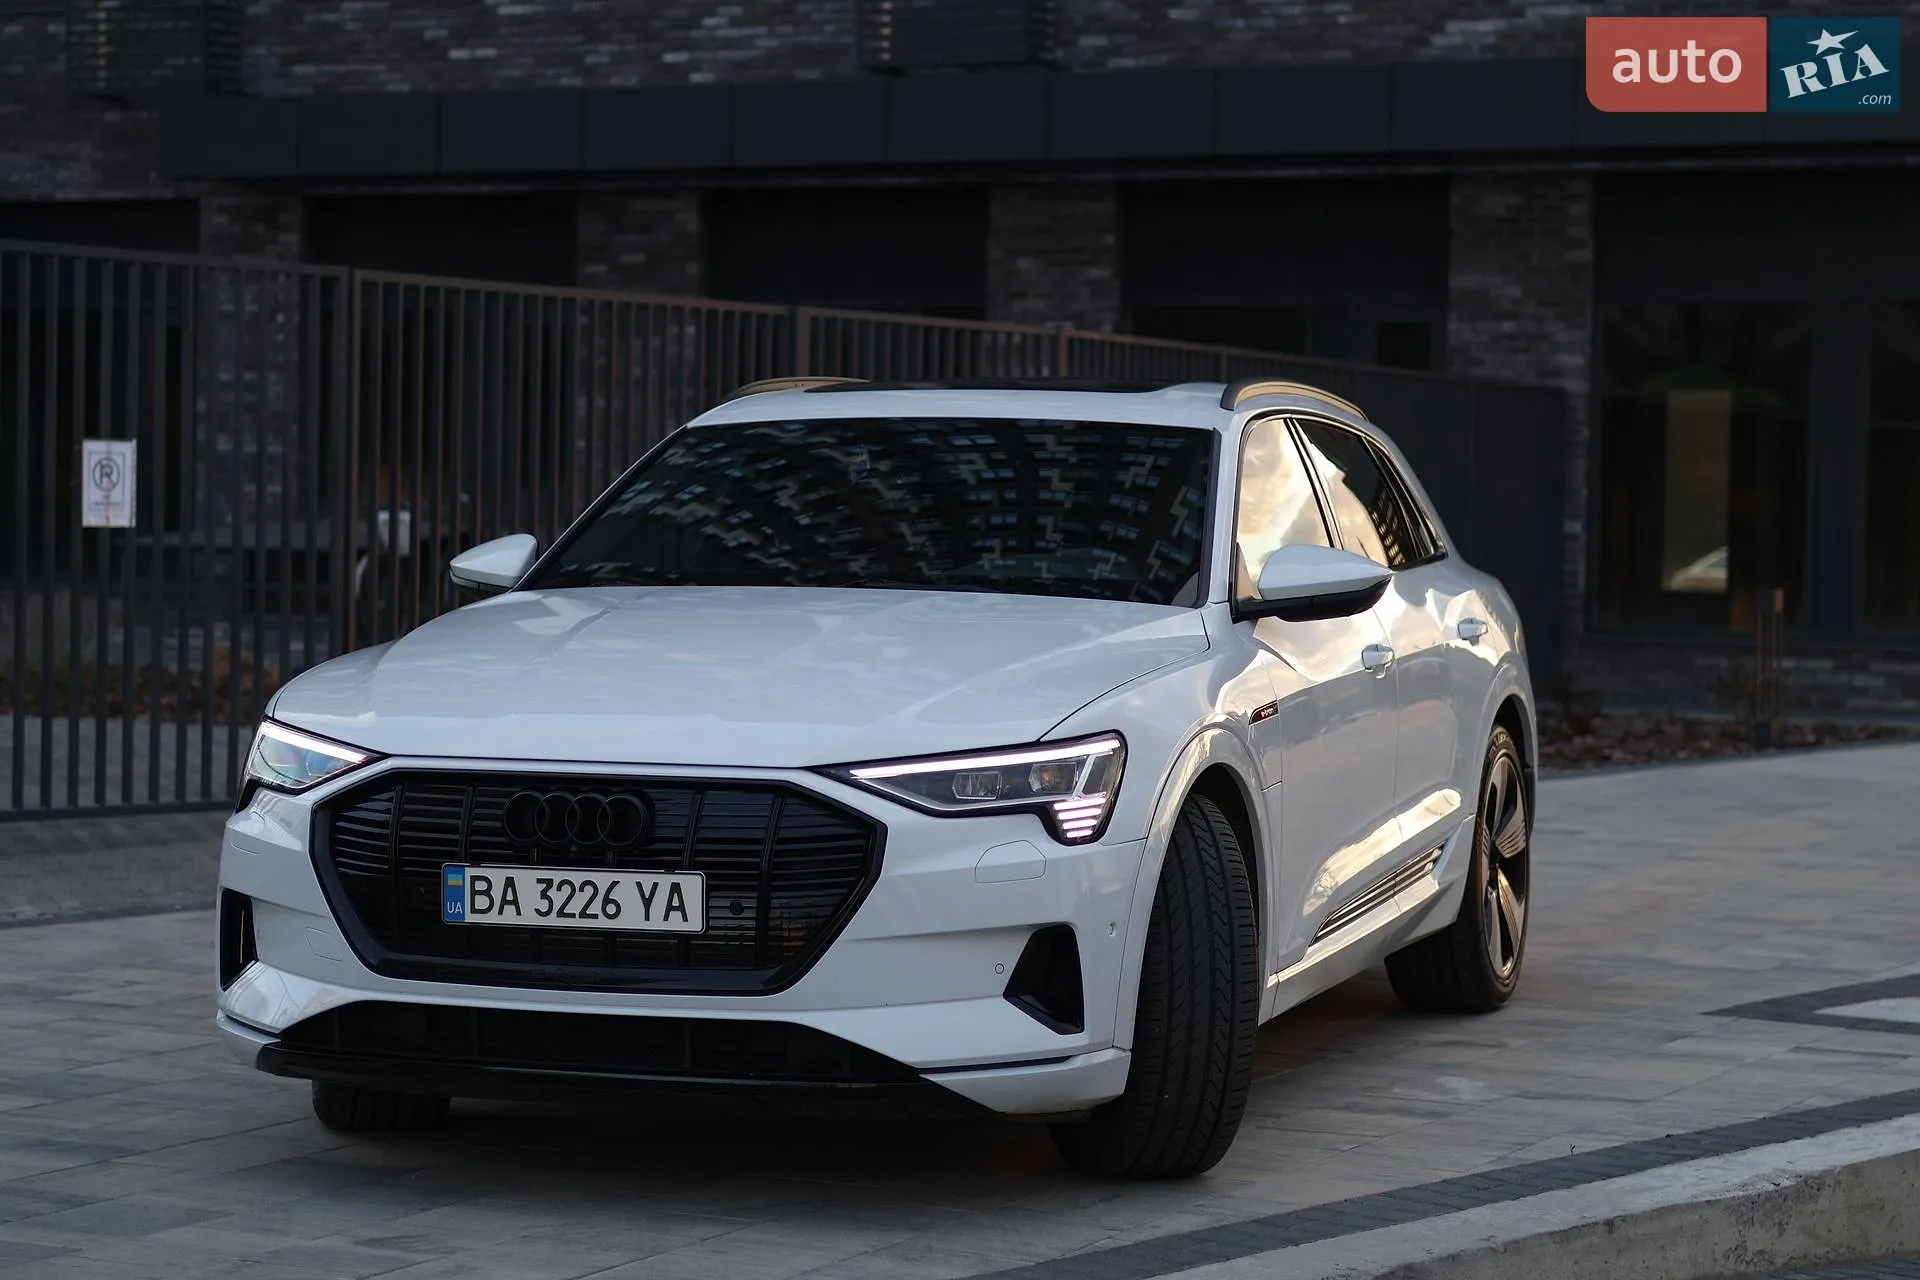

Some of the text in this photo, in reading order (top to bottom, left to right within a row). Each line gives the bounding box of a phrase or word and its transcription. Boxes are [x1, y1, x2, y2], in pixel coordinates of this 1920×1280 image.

[447, 901, 463, 914] UA
[470, 875, 689, 922] BA 3226 YA
